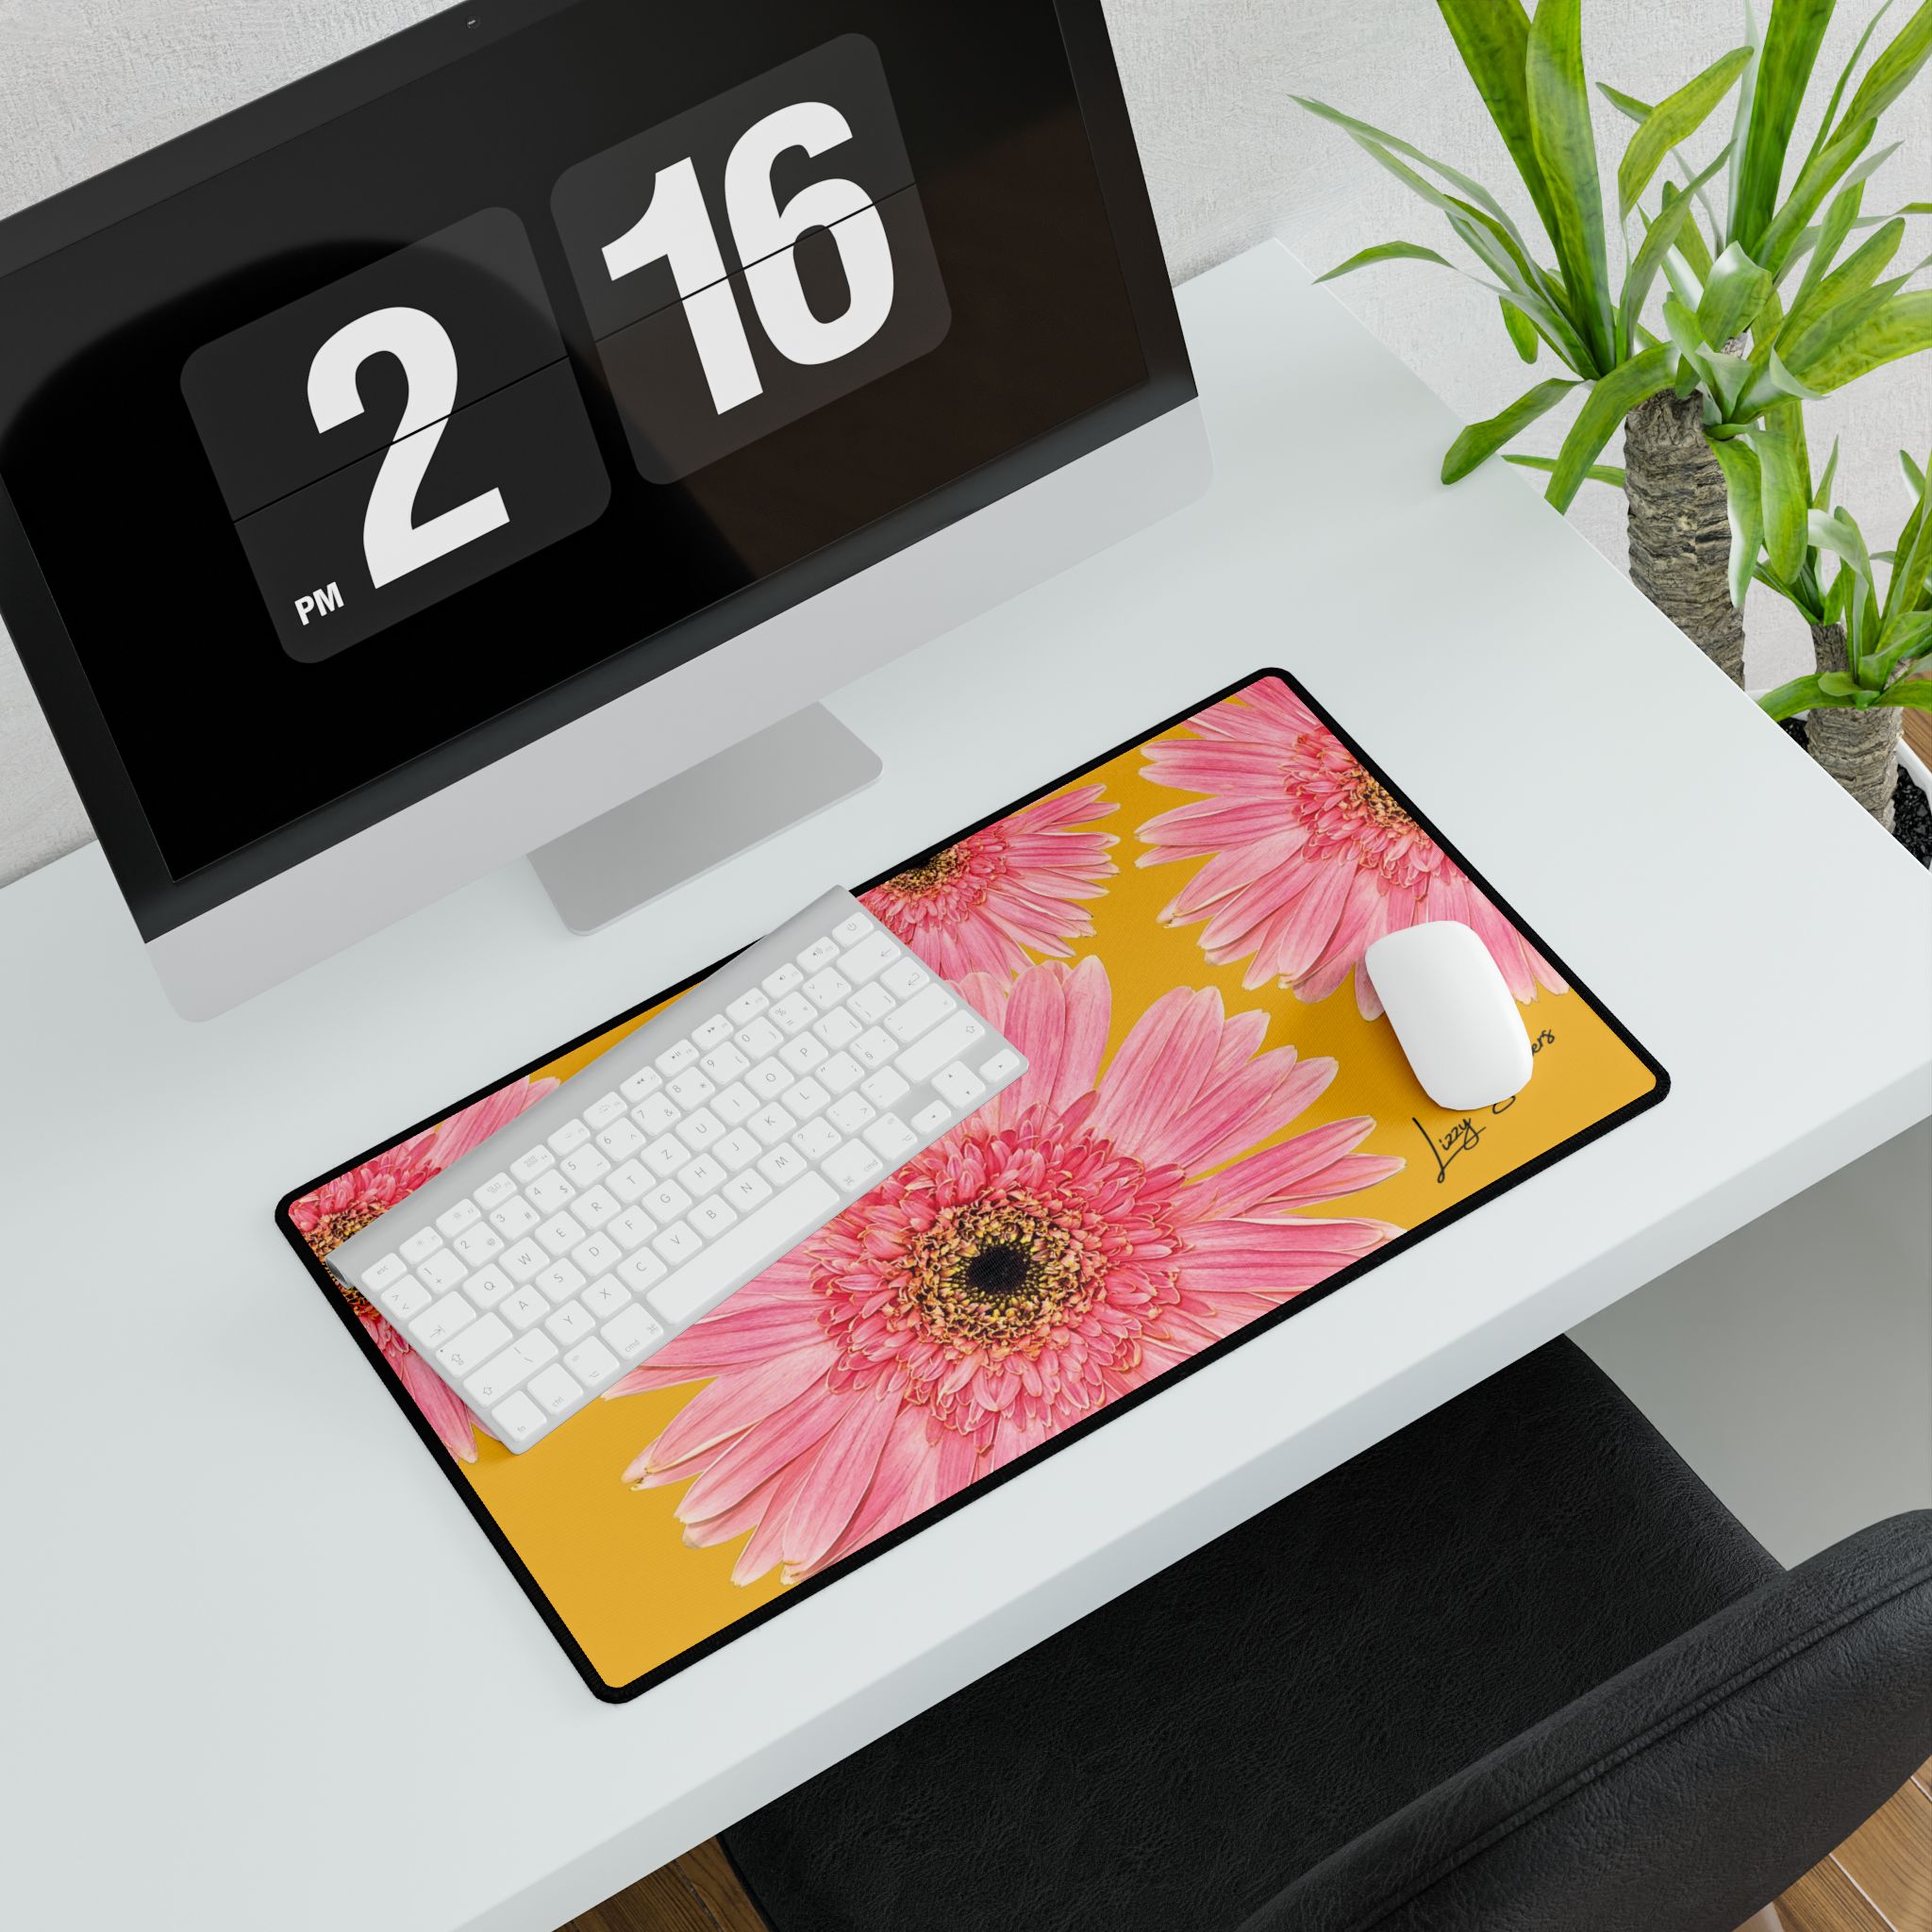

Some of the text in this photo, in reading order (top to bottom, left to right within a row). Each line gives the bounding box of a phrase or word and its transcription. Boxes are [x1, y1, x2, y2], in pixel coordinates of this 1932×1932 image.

[308, 102, 893, 590] 2 16
[294, 582, 343, 625] PM
[459, 1240, 471, 1251] 2
[495, 1213, 507, 1224] 3
[533, 1186, 542, 1196] 4
[566, 1160, 577, 1172] 5
[603, 1135, 612, 1145] 6
[636, 1108, 646, 1120] 7
[671, 1084, 682, 1094] 8
[706, 1058, 716, 1069] 9
[483, 1280, 497, 1291] Q
[517, 1252, 532, 1266] W
[555, 1227, 567, 1239] E
[590, 1201, 604, 1212] R
[625, 1174, 637, 1186] T
[660, 1148, 674, 1161] Z
[694, 1122, 708, 1135] U
[799, 1046, 808, 1058] P
[518, 1299, 529, 1311] A
[553, 1273, 564, 1284] S
[588, 1245, 601, 1257] D
[624, 1219, 634, 1230] F
[658, 1192, 672, 1205] G
[693, 1166, 708, 1179] H
[731, 1141, 741, 1152] J
[763, 1115, 776, 1127] K
[798, 1091, 810, 1101] L
[561, 1314, 574, 1325] Y
[598, 1287, 612, 1300] X
[635, 1260, 648, 1273] C
[669, 1234, 681, 1245] V
[705, 1208, 718, 1221] B
[740, 1181, 754, 1194] N
[774, 1156, 790, 1169] M
